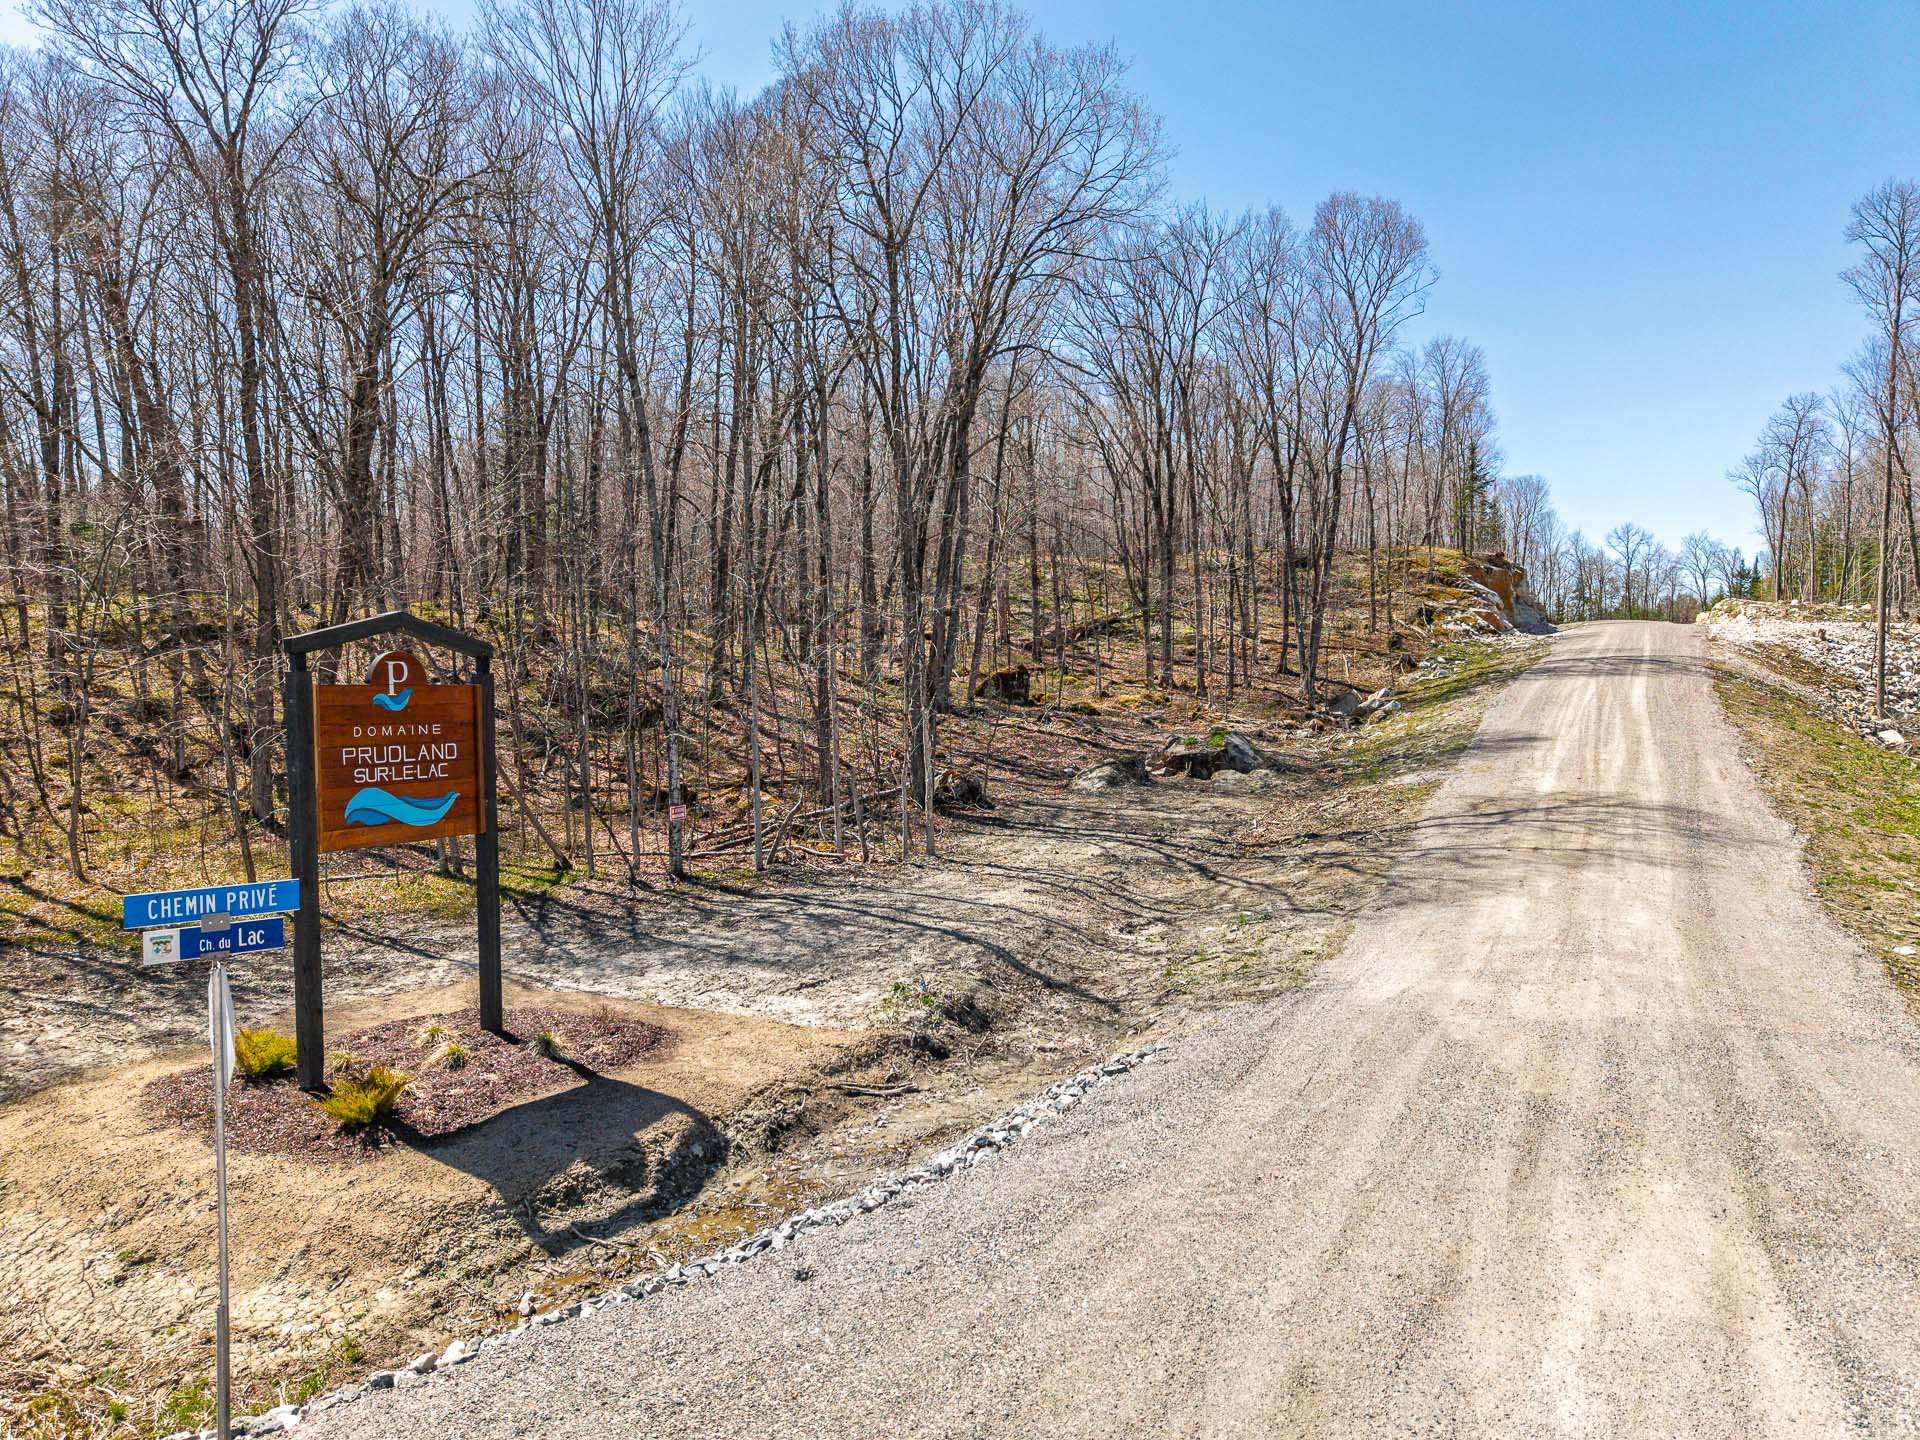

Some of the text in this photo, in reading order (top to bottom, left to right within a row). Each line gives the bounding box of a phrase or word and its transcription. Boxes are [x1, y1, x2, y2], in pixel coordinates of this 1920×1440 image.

[353, 724, 441, 737] DOMAINE
[342, 743, 458, 766] PRUDLAND
[353, 763, 449, 783] SUR-LE-LAC
[148, 884, 278, 920] CHEMIN PRIVÉ
[199, 928, 265, 952] Ch. du Lac
